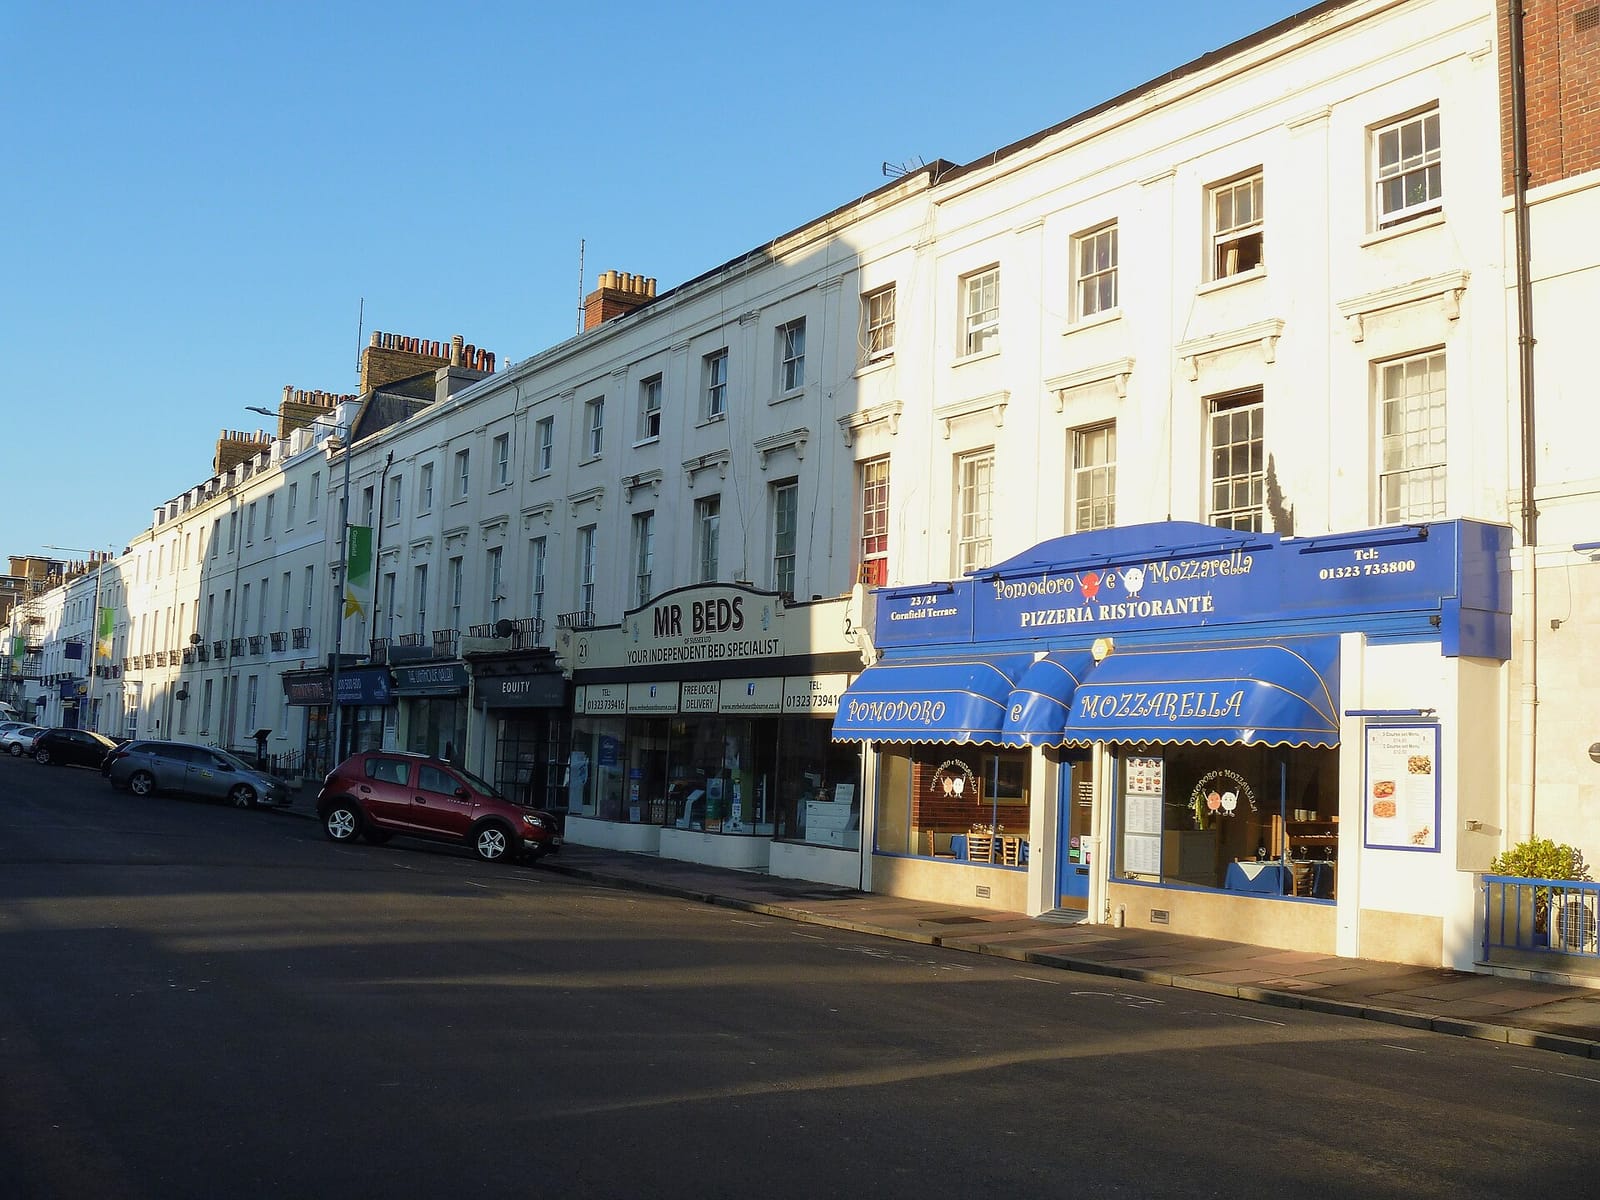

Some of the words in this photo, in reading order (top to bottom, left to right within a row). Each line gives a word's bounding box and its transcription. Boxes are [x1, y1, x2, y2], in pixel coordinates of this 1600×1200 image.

[1354, 548, 1379, 561] Tel:
[993, 575, 1074, 600] Pomodoro
[1105, 573, 1115, 589] e
[1149, 549, 1253, 585] Mozzarella
[1319, 565, 1361, 580] 01323
[1364, 560, 1416, 576] 733800
[910, 594, 937, 607] 23/24
[653, 604, 683, 638] MR
[692, 596, 744, 635] BEDS
[890, 608, 927, 621] Cornfield
[927, 607, 958, 618] Terrace
[1020, 606, 1094, 628] PIZZERIA
[579, 644, 588, 657] 21
[627, 649, 648, 665] YOUR
[649, 644, 706, 662] INDEPENDENT
[707, 642, 726, 659] BED
[727, 639, 779, 657] SPECIALIST
[502, 681, 530, 693] EQUITY
[683, 685, 698, 696] FREE
[698, 684, 718, 695] LOCAL
[808, 680, 822, 691] TEL:
[602, 688, 611, 697] TEL:
[587, 700, 603, 711] 01323
[604, 699, 625, 711] 739416
[685, 698, 714, 710] DELIVERY
[786, 695, 811, 708] 01323
[812, 694, 841, 707] 73941
[847, 698, 946, 724] POMODORO
[1010, 703, 1023, 722] e
[1080, 689, 1245, 721] MOZZARELLA
